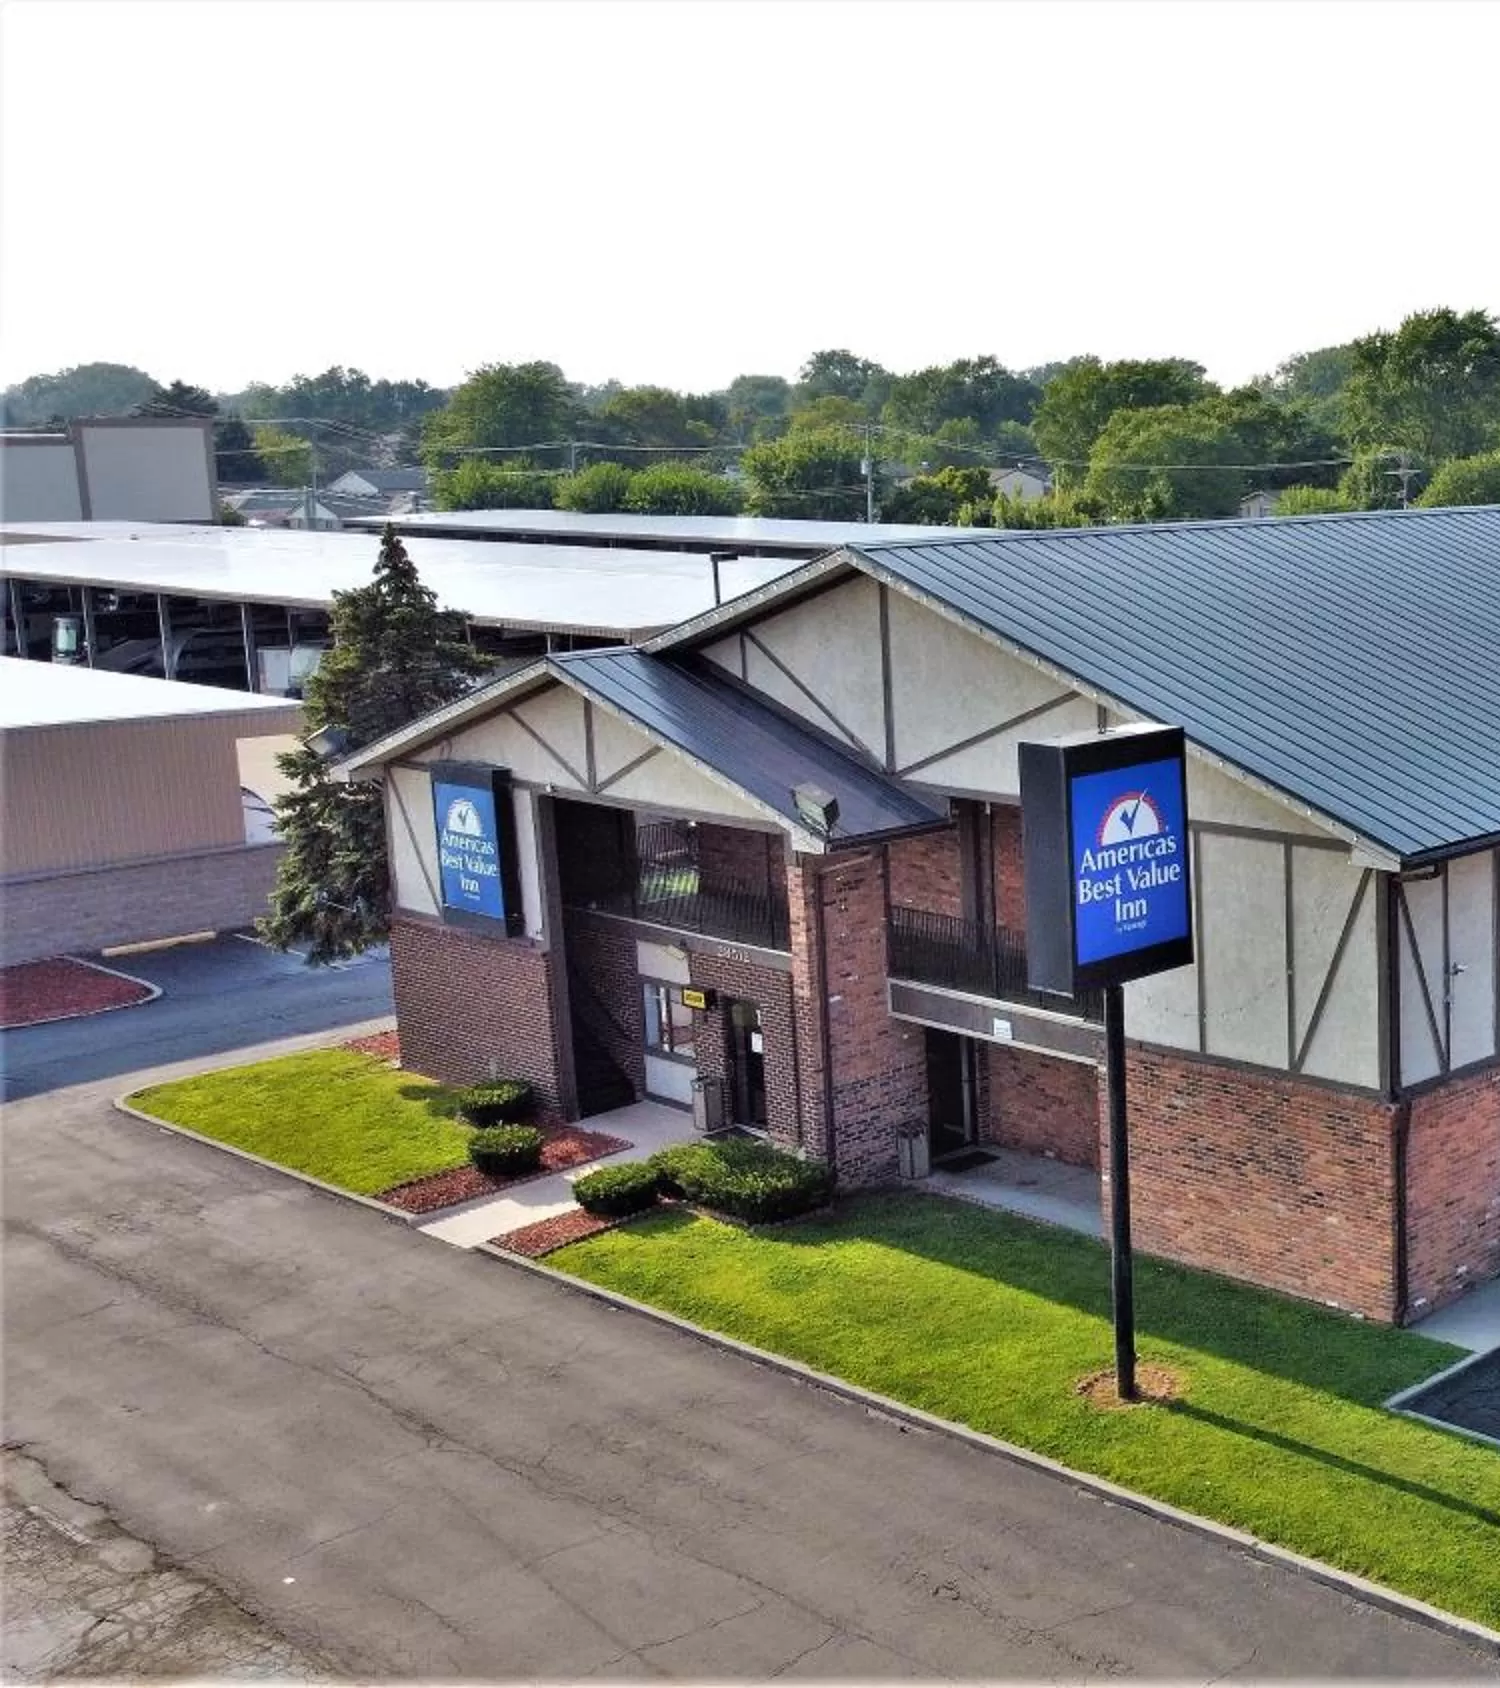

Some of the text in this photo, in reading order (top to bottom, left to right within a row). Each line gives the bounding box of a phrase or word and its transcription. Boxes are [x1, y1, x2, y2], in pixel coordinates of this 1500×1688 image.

[442, 828, 495, 854] Americas
[1080, 835, 1177, 874] Americas
[441, 848, 498, 877] Best Value
[460, 874, 480, 893] Inn
[1079, 861, 1181, 905] Best Value
[1115, 897, 1147, 923] Inn
